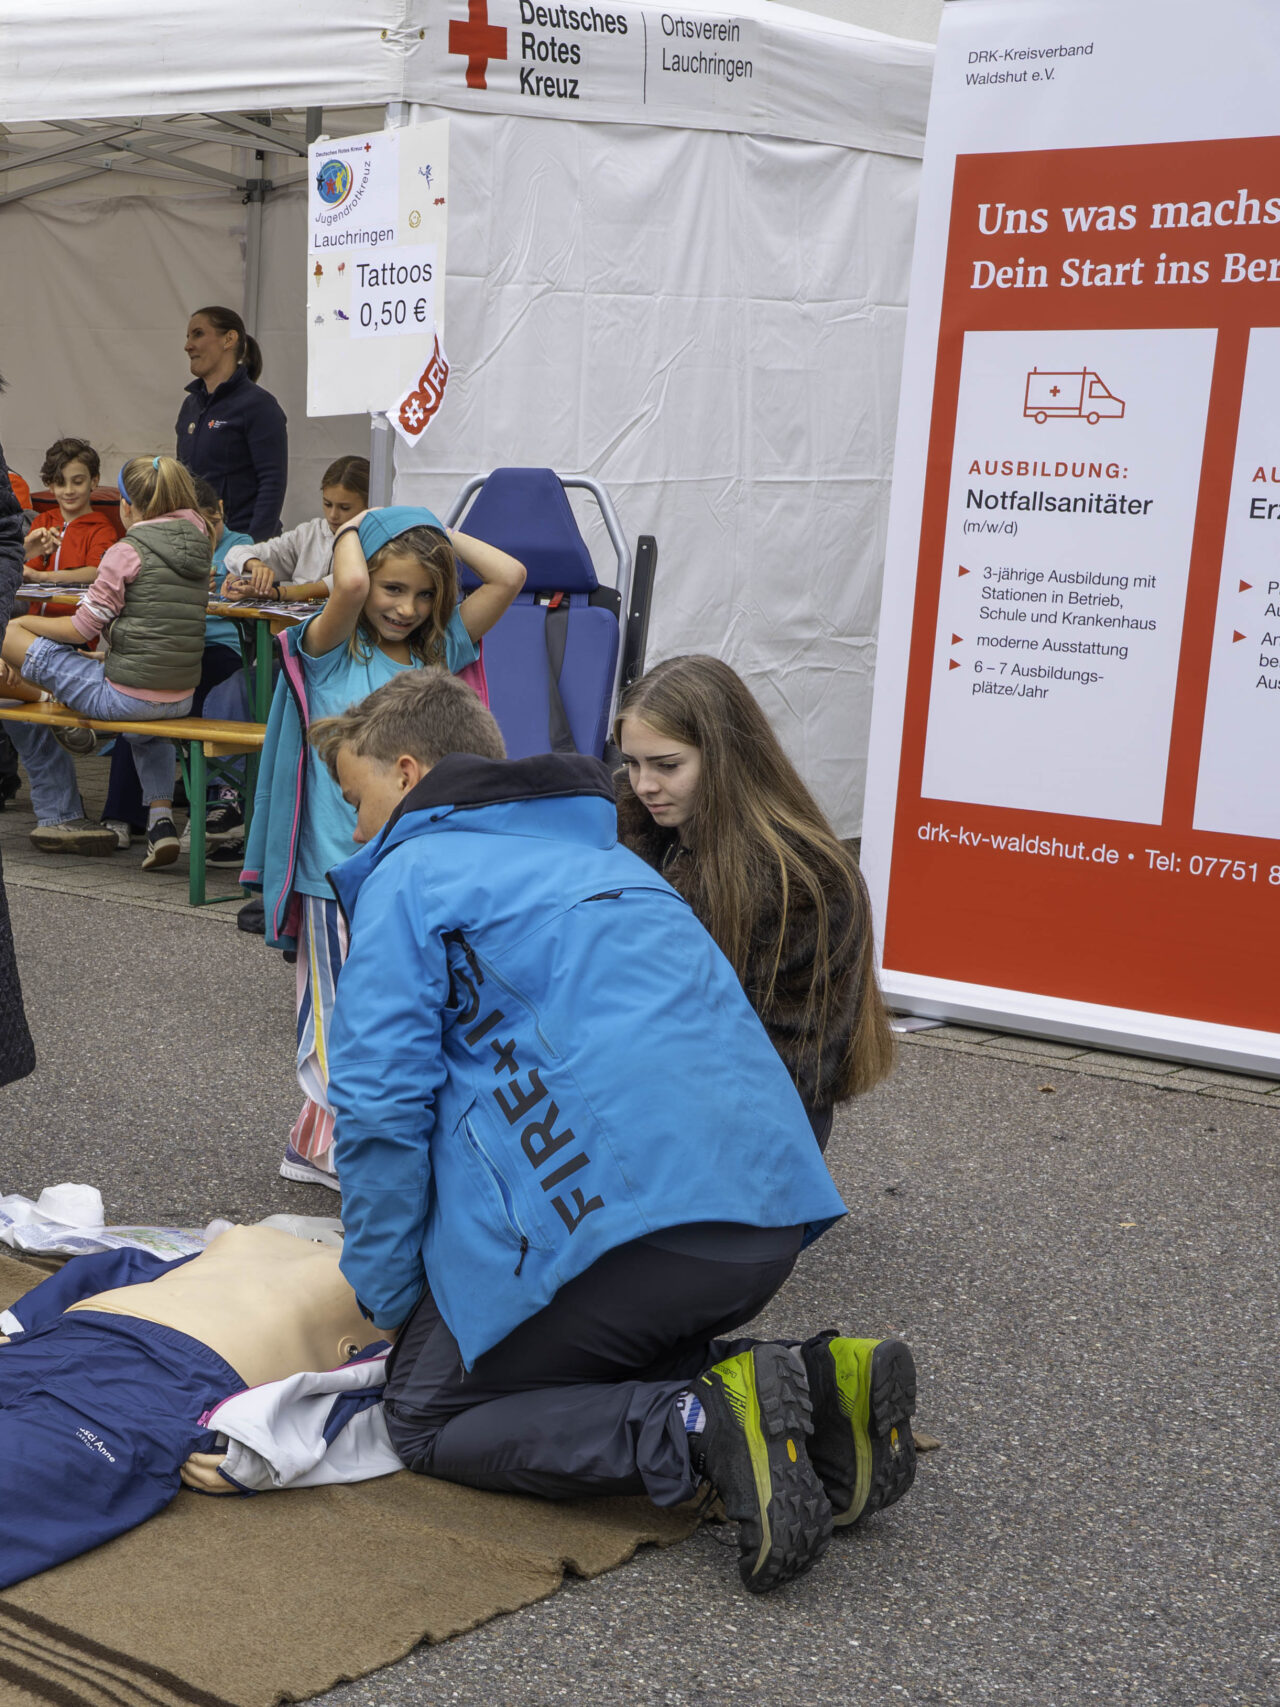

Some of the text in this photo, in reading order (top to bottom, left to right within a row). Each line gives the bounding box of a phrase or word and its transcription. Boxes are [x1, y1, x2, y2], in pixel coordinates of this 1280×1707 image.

[519, 0, 628, 35] Deutsches
[661, 13, 741, 42] Ortsverein
[521, 32, 581, 65] Rotes
[968, 42, 1094, 64] DRK-Kreisverband
[662, 48, 753, 82] Lauchringen
[965, 67, 1055, 86] Waldshut e.V.
[519, 67, 580, 100] Kreuz
[315, 160, 372, 227] Jugendrotkreuz
[977, 188, 1280, 235] Uns was machs
[314, 228, 394, 248] Lauchringen
[356, 262, 432, 288] Tattoos
[970, 252, 1280, 289] Dein Start ins Ber
[360, 297, 427, 331] 0,50 €
[968, 460, 1129, 479] AUSBILDUNG:
[965, 488, 1154, 515] Notfallsanitäter
[1249, 497, 1280, 520] Er
[963, 518, 1018, 537] (m/w/d)
[983, 566, 1157, 590] 3-jährige Ausbildung mit
[1267, 581, 1280, 595] P
[981, 586, 1124, 609] Stationen in Betrieb,
[979, 606, 1157, 631] Schule und Krankenhaus
[976, 635, 1129, 660] moderne Ausstattung
[1259, 653, 1280, 669] be
[1010, 663, 1104, 685] Ausbildungs-
[971, 681, 1049, 699] plätze/Jahr
[917, 822, 1120, 864] drk-kv-waldshut.de
[1144, 848, 1182, 873] Tel:
[1189, 855, 1258, 883] 07751
[441, 928, 606, 1236] FIRE+IC
[93, 1441, 116, 1463] Anne
